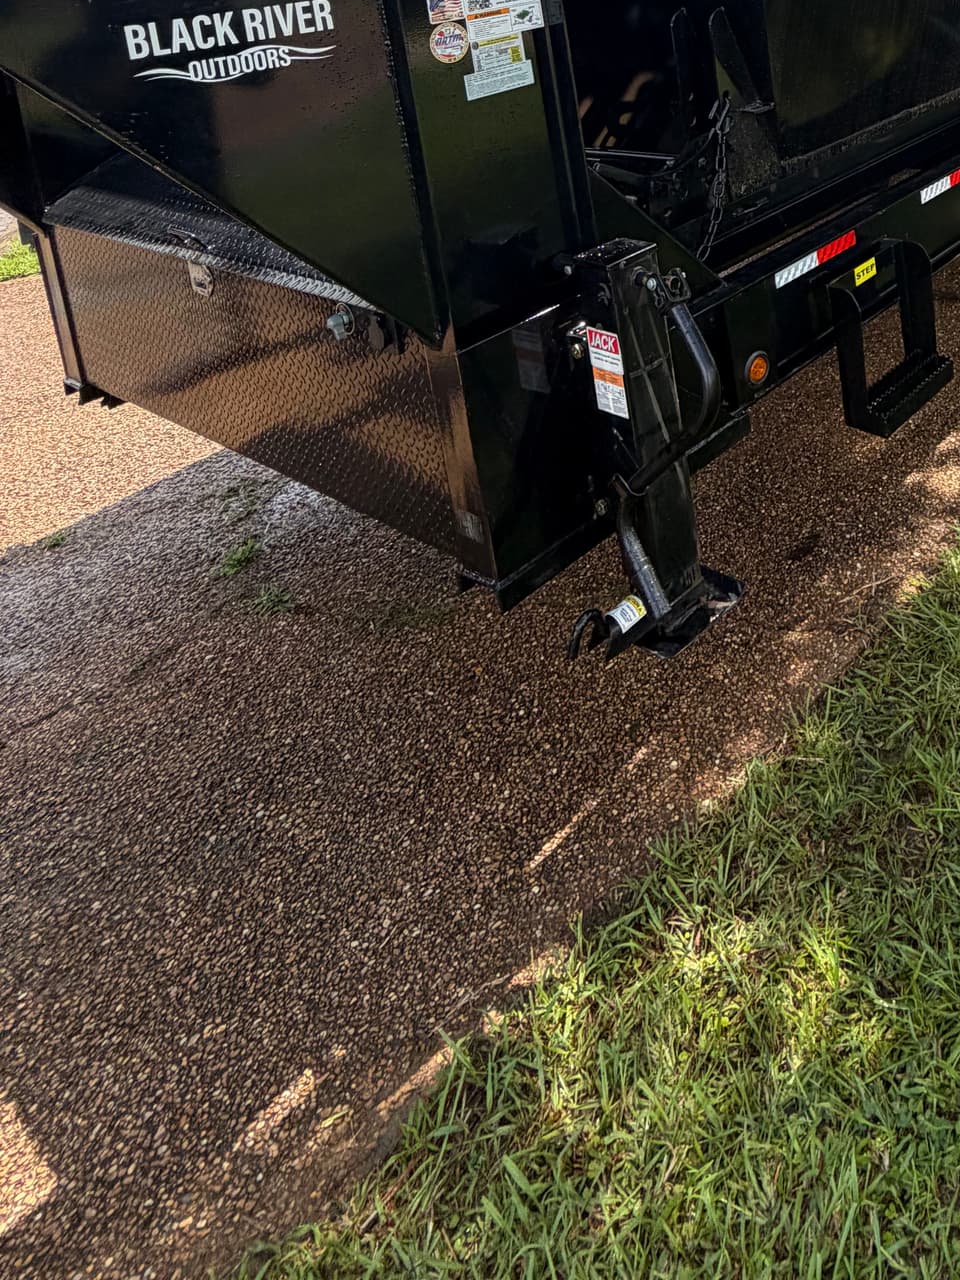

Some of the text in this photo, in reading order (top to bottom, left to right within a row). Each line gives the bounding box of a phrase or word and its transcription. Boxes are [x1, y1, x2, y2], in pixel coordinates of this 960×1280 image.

[124, 11, 239, 61] BLACK
[188, 47, 292, 81] OUTDOORS
[856, 263, 875, 280] STEP
[591, 331, 616, 352] JACK
